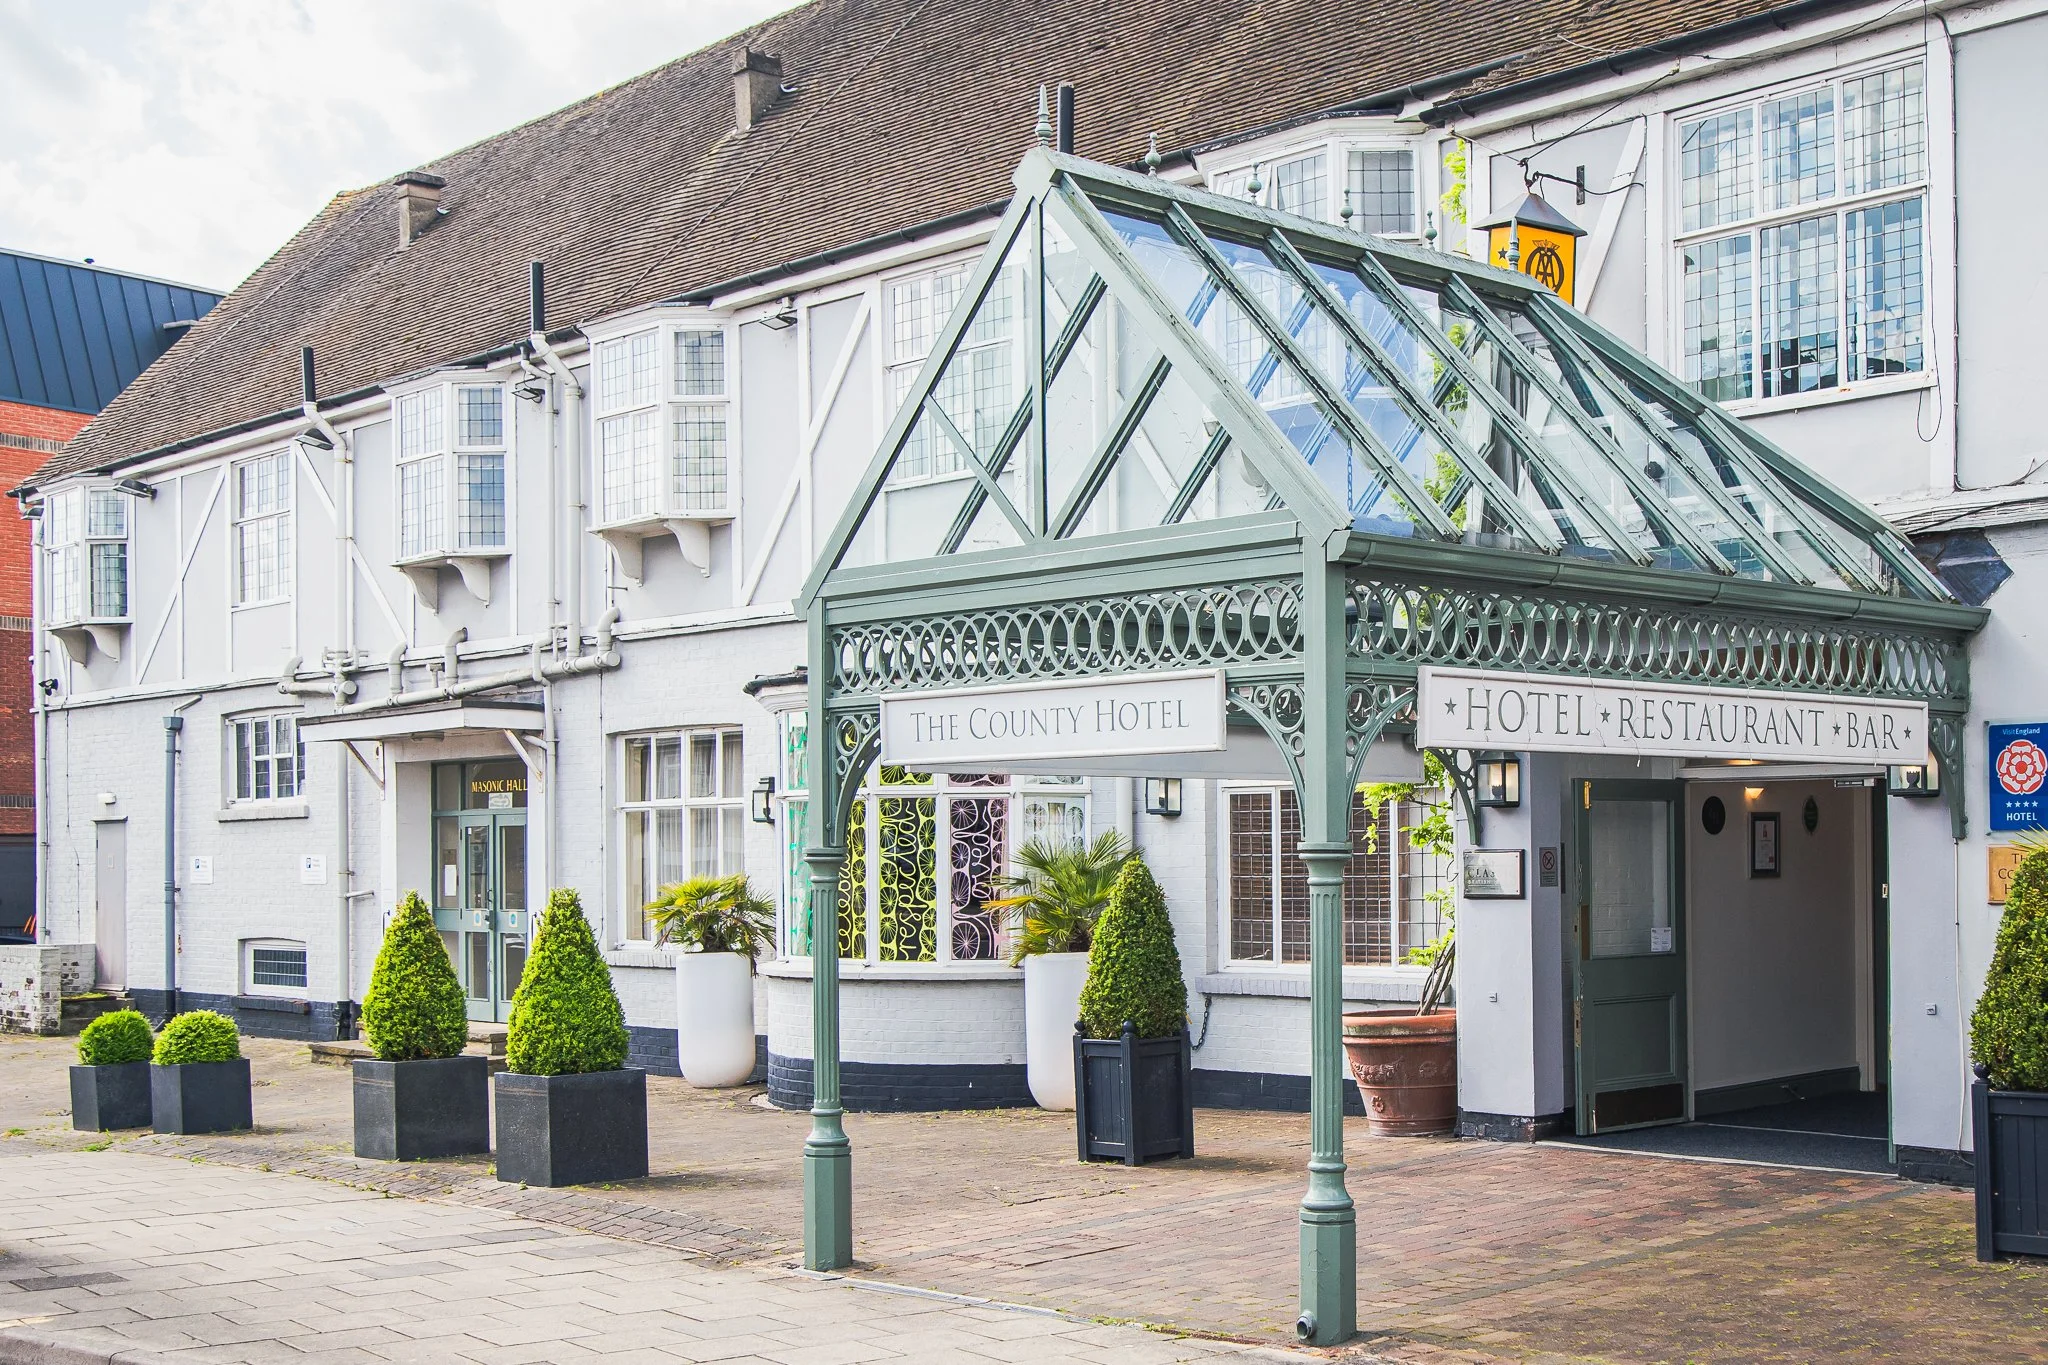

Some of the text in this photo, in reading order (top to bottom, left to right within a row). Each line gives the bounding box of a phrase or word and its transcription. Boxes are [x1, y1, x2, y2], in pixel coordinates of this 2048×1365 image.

[1533, 250, 1558, 290] AA
[1465, 687, 1900, 750] HOTEL RESTAURANT BAR
[471, 778, 528, 793] MASONIC HALL
[2006, 811, 2038, 821] HOTEL
[880, 801, 929, 960] respected
